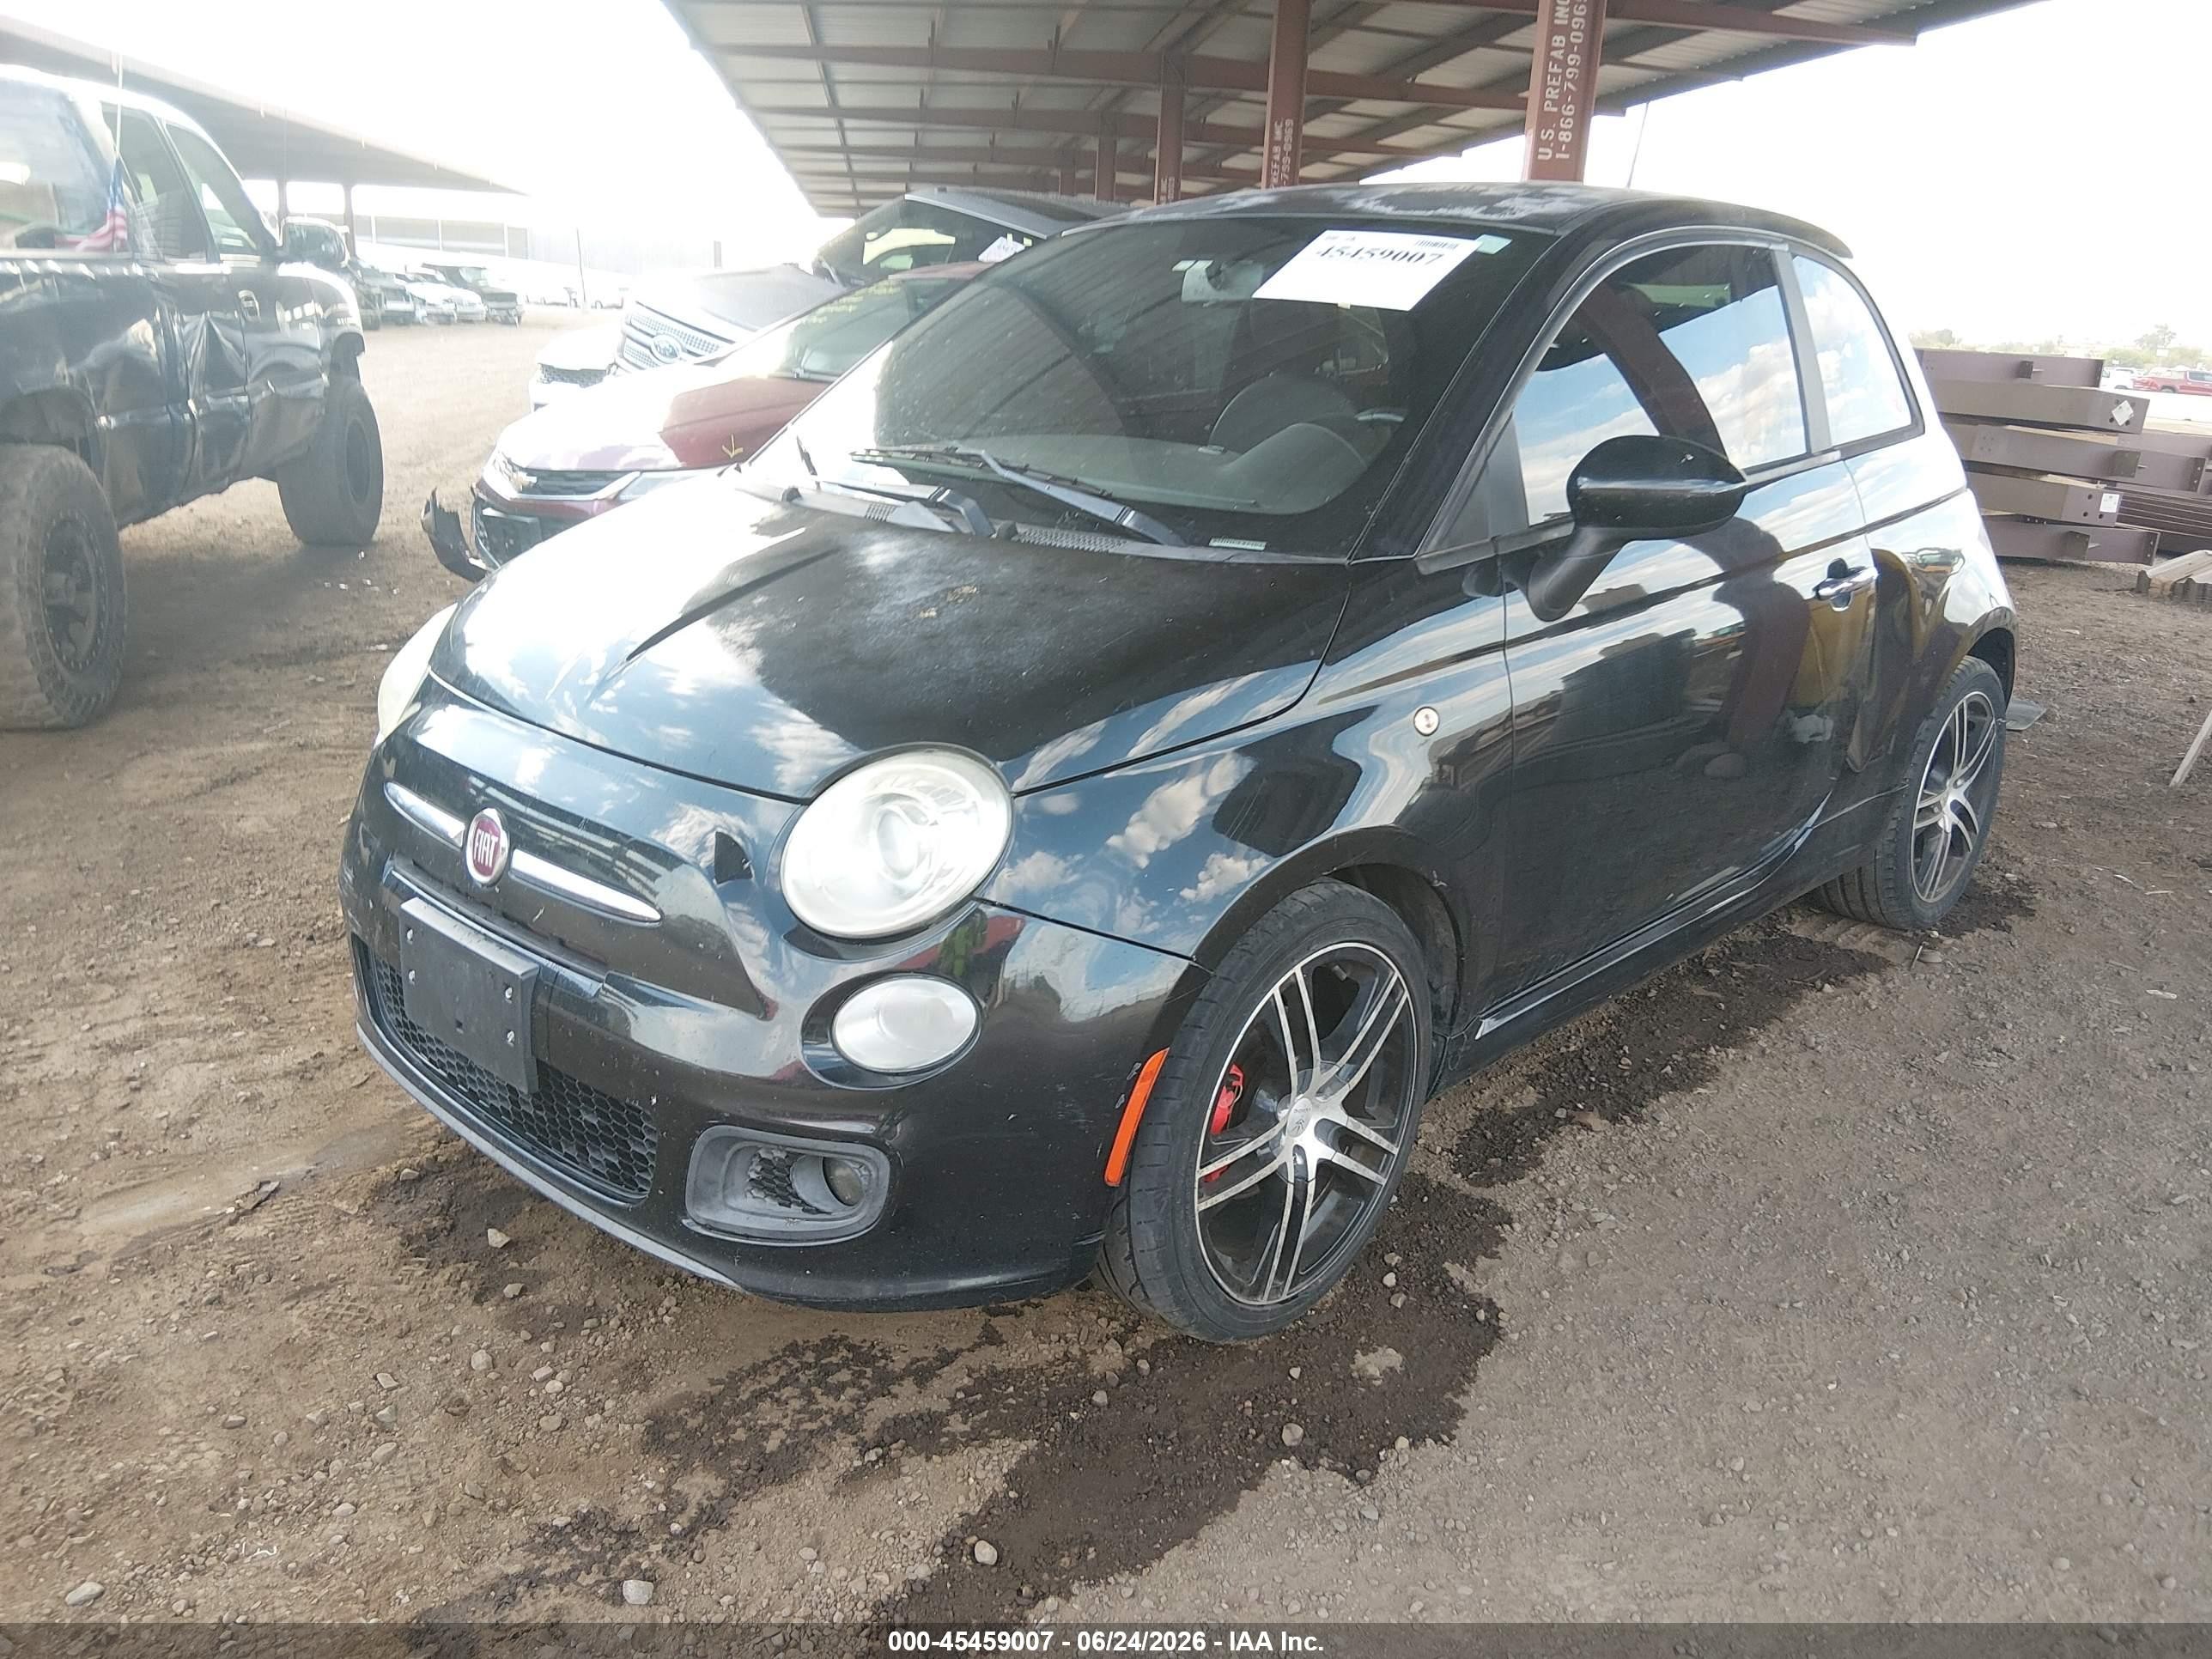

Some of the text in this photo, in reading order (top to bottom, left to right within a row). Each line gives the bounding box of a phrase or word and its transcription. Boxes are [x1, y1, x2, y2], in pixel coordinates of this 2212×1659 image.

[1543, 34, 1566, 112] PREFAB
[1555, 0, 1588, 159] 1-866-799-096
[1537, 123, 1556, 161] U.S.
[1316, 246, 1444, 265] 45459007
[473, 828, 499, 868] FIAT
